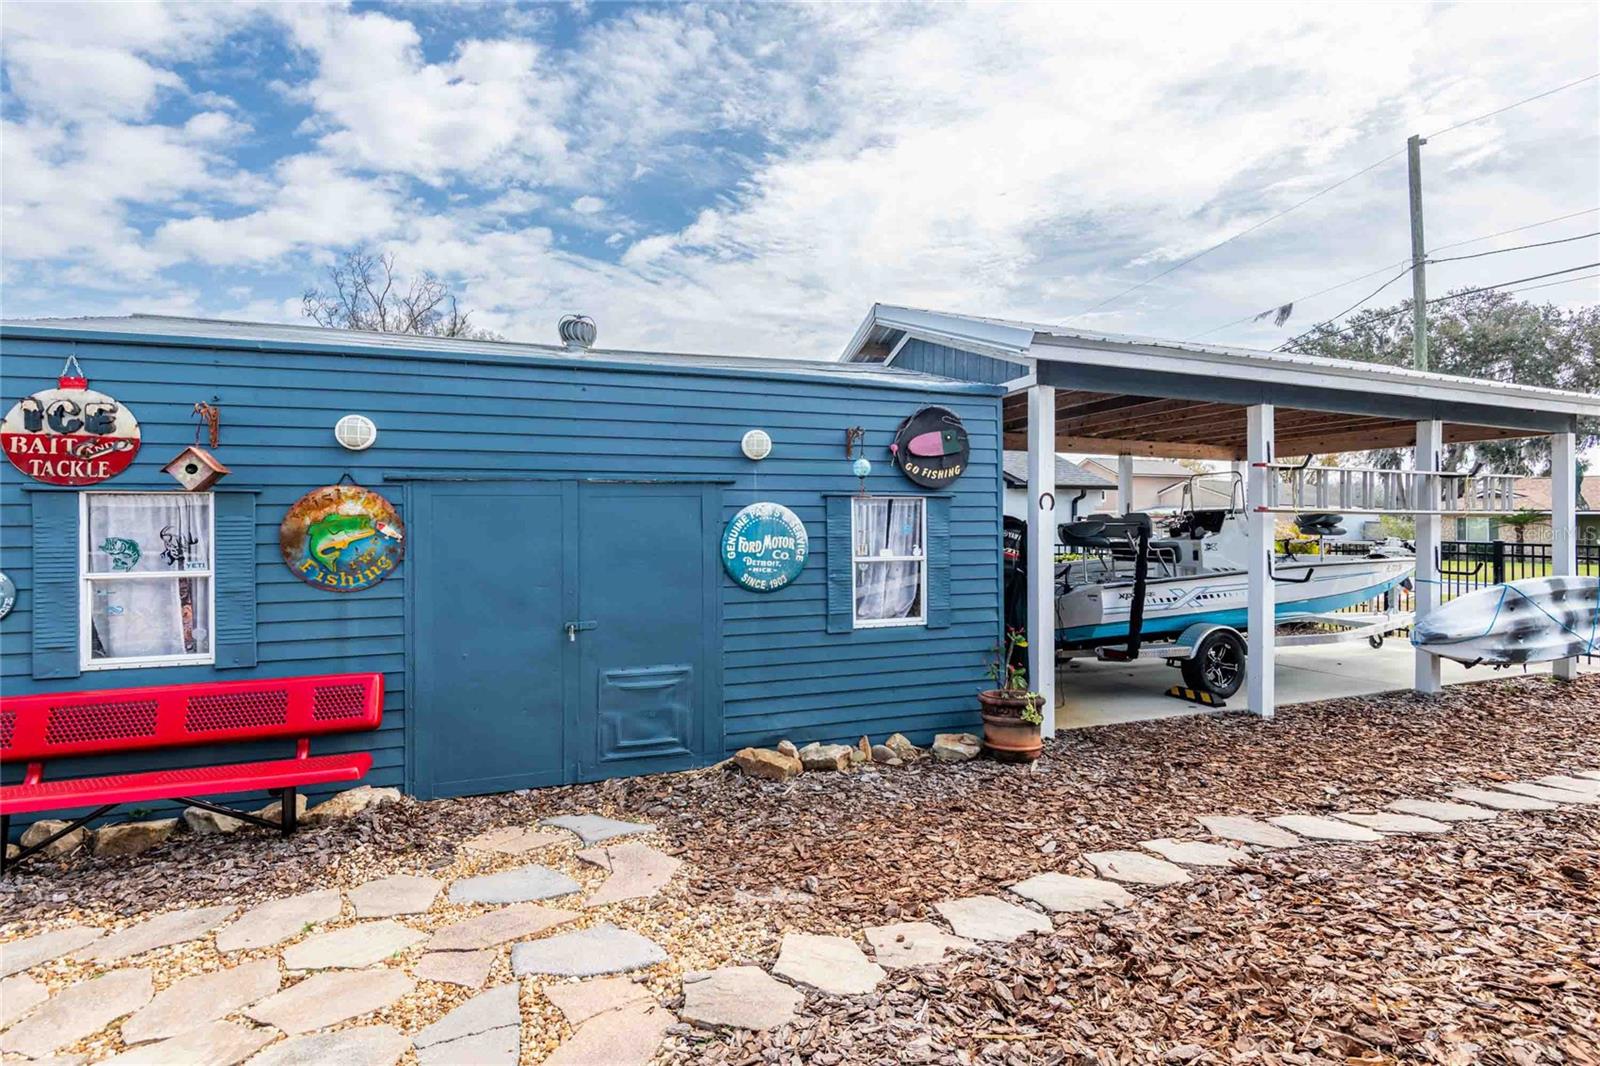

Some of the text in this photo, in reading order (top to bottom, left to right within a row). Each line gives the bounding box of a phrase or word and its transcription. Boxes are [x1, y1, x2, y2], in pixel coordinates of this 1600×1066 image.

[21, 396, 119, 435] ICE
[9, 436, 79, 455] BAIT
[29, 459, 111, 478] TACKLE
[904, 462, 961, 480] GO FISHING
[727, 514, 750, 559] GENUINE
[789, 521, 806, 562] SERVICE
[762, 534, 795, 550] MOTOR
[300, 556, 393, 587] Fishing
[741, 573, 788, 589] SINCE 1903
